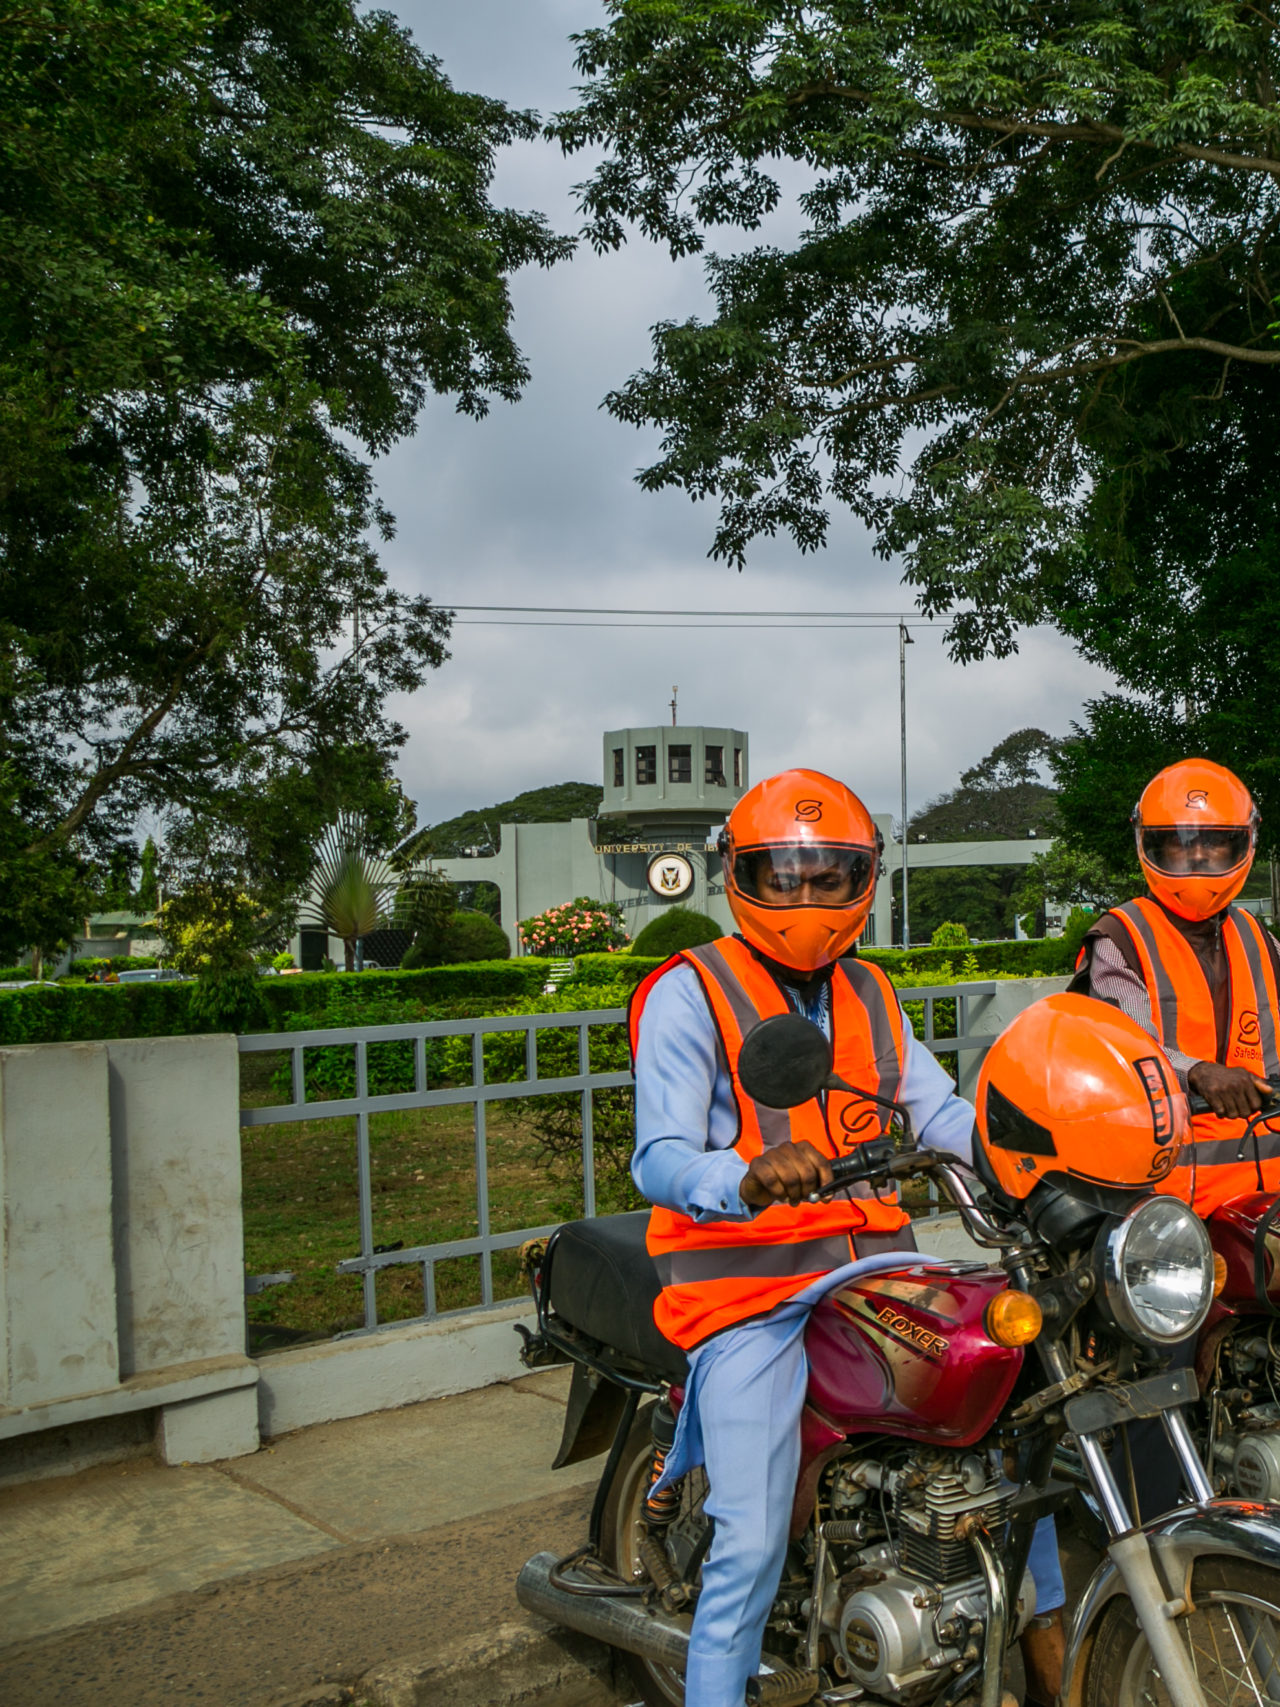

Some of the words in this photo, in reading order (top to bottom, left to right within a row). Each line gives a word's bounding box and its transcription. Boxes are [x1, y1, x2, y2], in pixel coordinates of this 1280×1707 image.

[594, 843, 664, 854] UNIVERSITY
[676, 843, 693, 852] OF
[876, 1306, 950, 1357] BOXER
